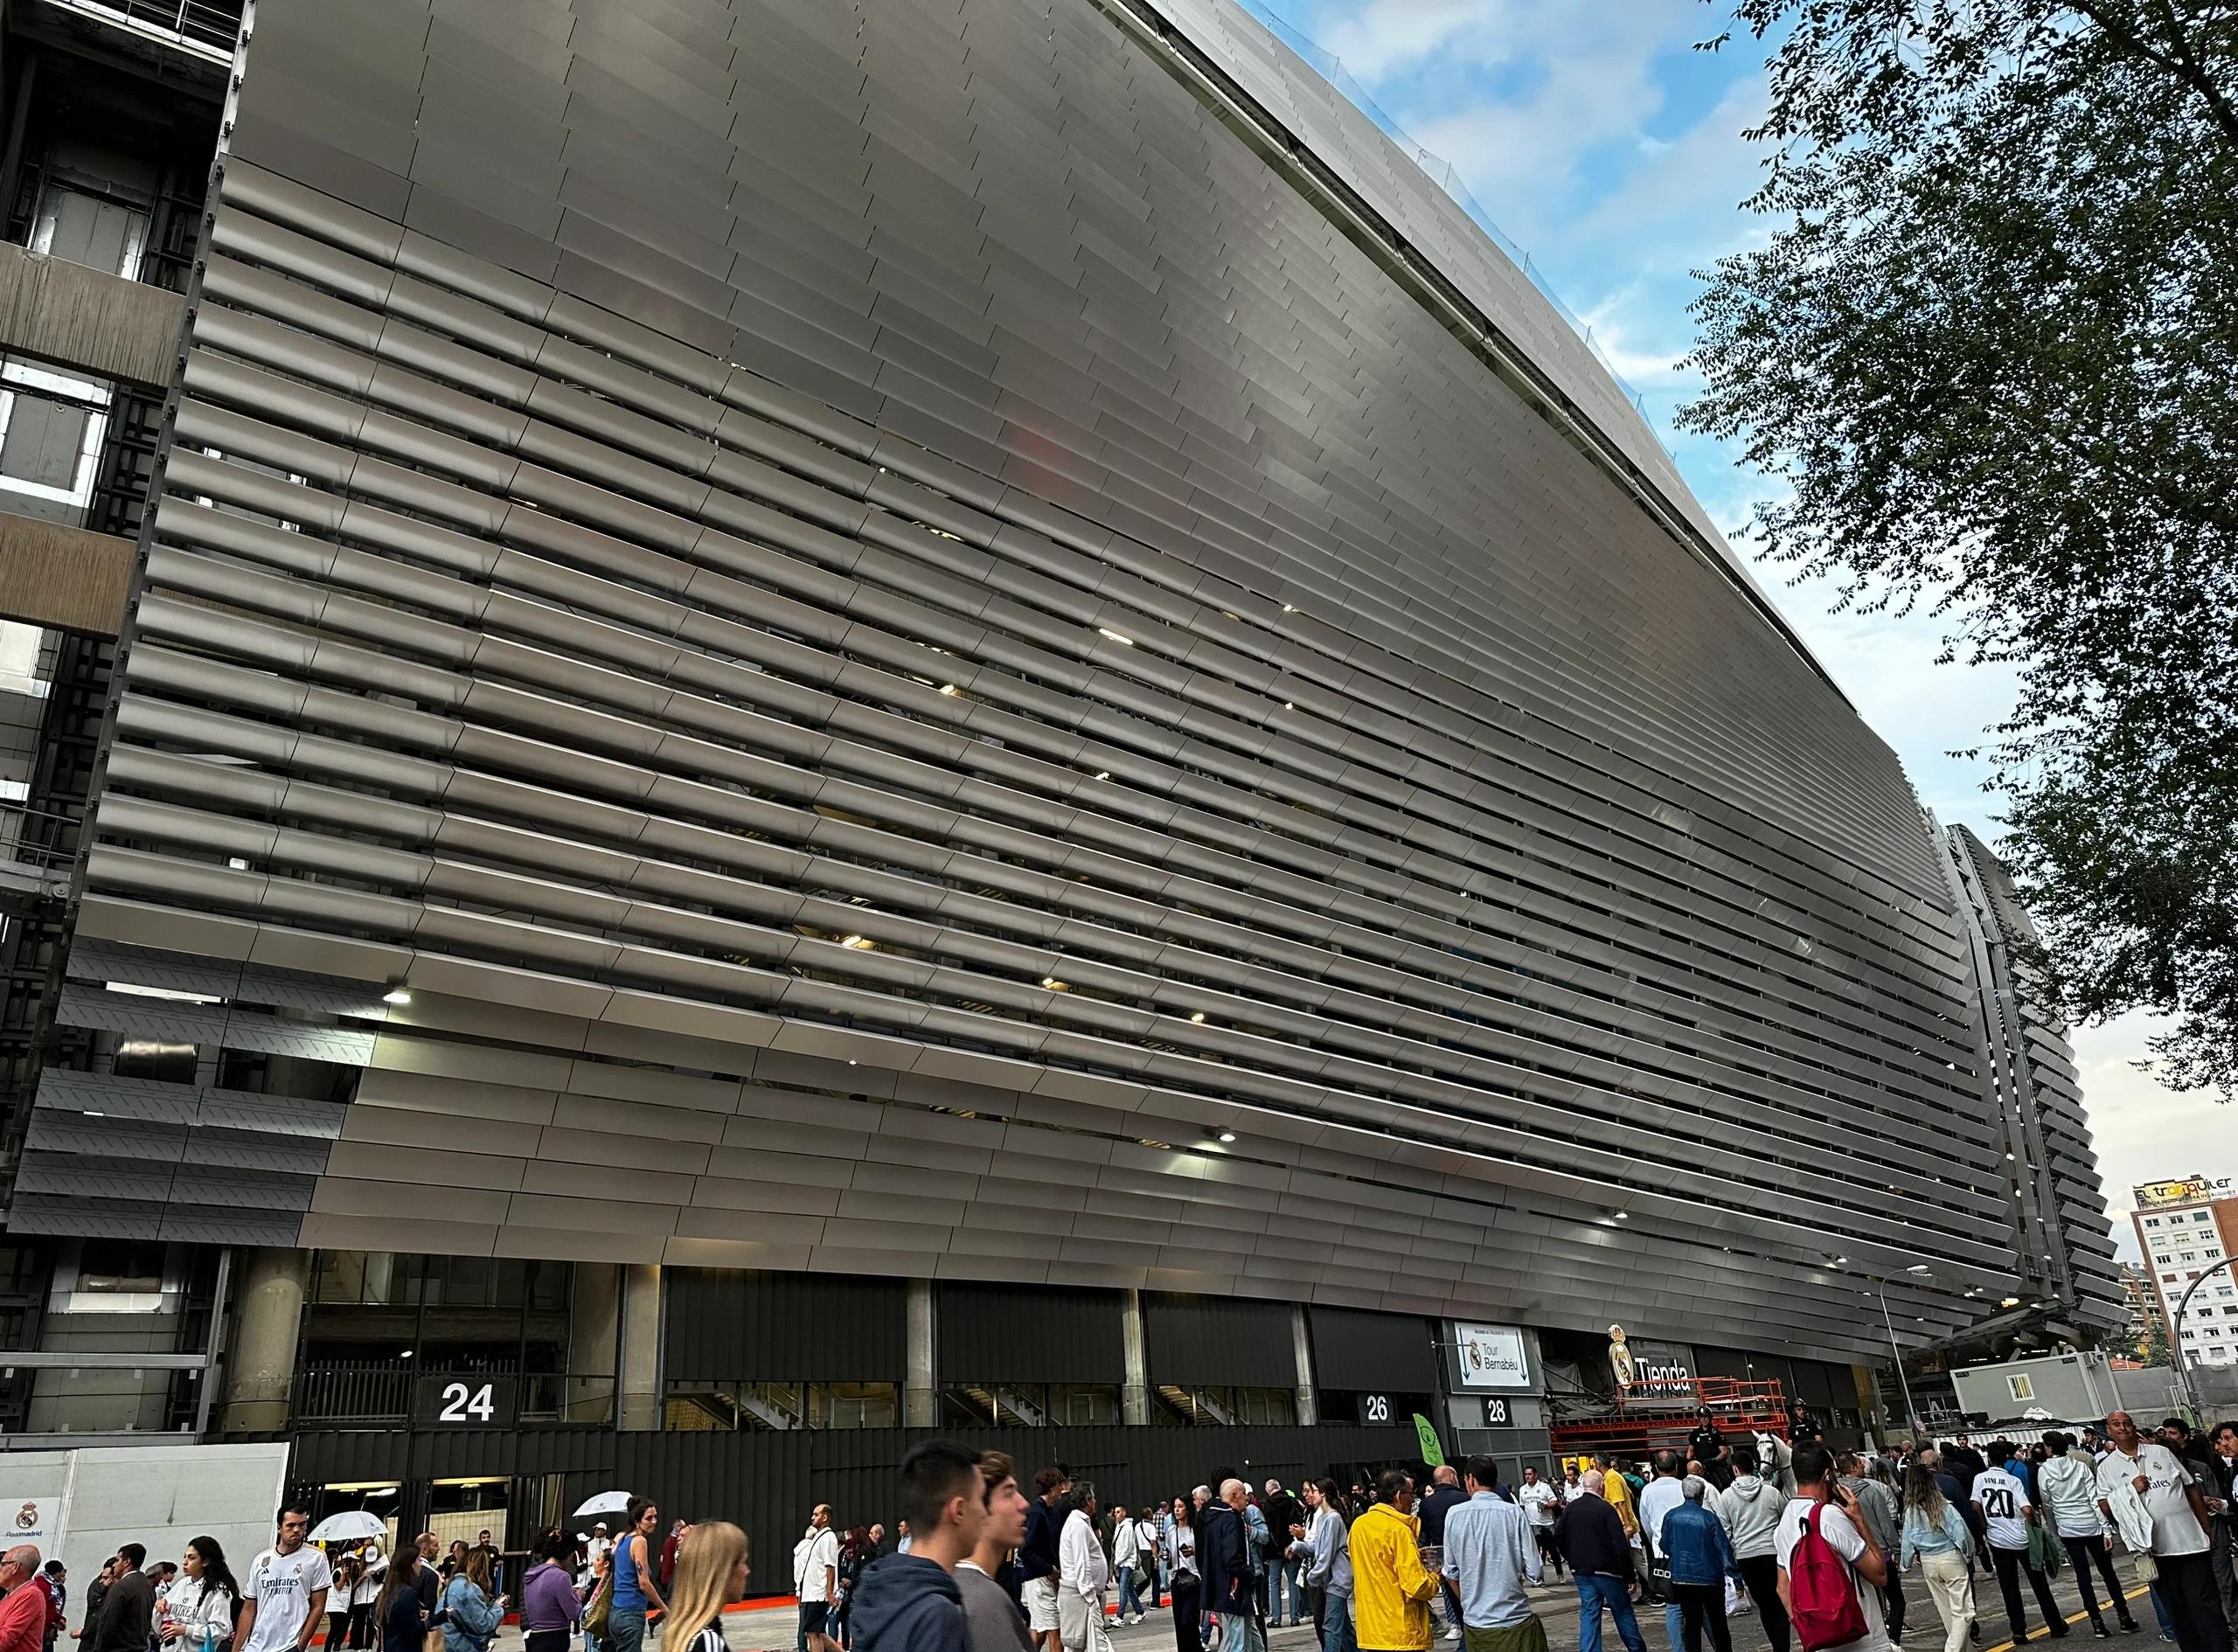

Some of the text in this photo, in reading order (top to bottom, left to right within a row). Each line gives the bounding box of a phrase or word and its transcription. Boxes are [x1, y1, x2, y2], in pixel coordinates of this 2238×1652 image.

[1482, 1343, 1498, 1356] Tour
[1484, 1357, 1518, 1371] Bernabéu
[1634, 1357, 1690, 1392] Tienda
[439, 1383, 494, 1421] 24
[1366, 1395, 1388, 1420] 26
[1488, 1399, 1506, 1422] 28
[1981, 1488, 2015, 1519] 20
[261, 1577, 299, 1589] Emirates
